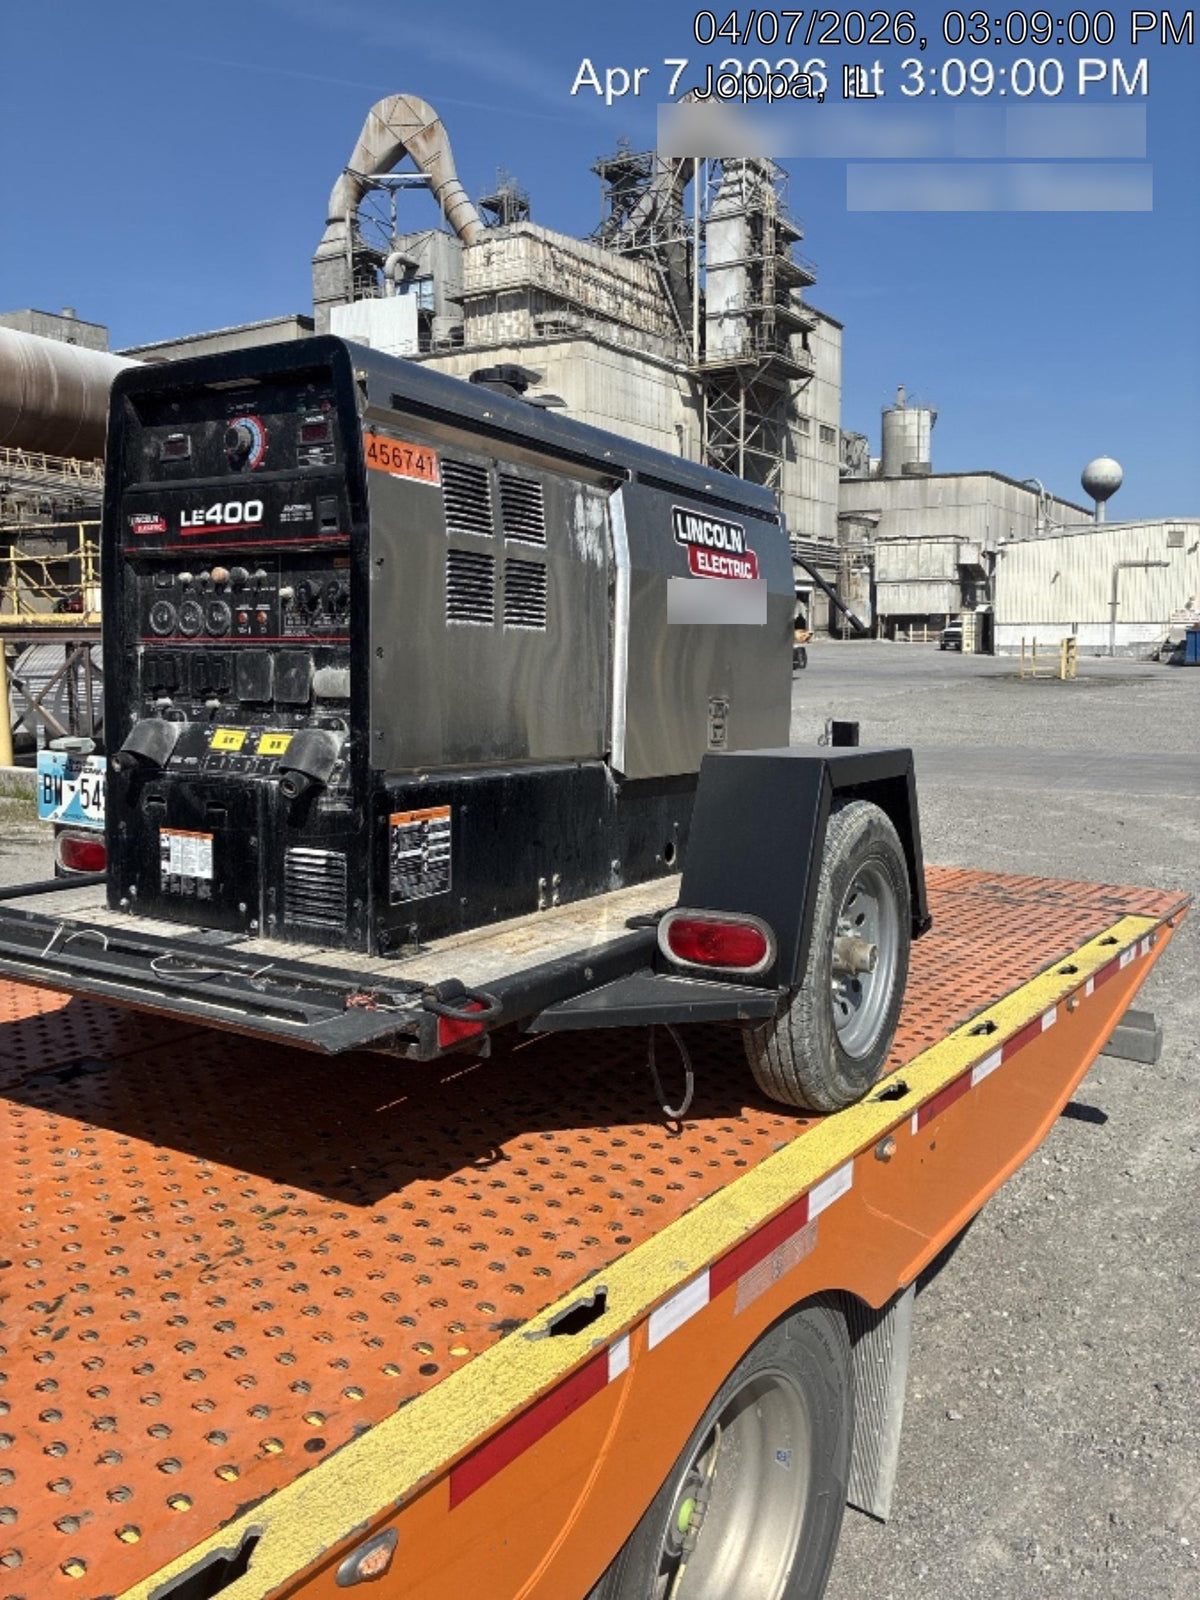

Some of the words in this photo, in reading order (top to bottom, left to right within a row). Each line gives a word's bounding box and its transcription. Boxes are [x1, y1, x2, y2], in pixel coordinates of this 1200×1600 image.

[367, 442, 433, 476] 456741
[180, 500, 264, 527] LE400
[676, 513, 743, 553] LINCOLN
[696, 550, 753, 579] ELECTRIC
